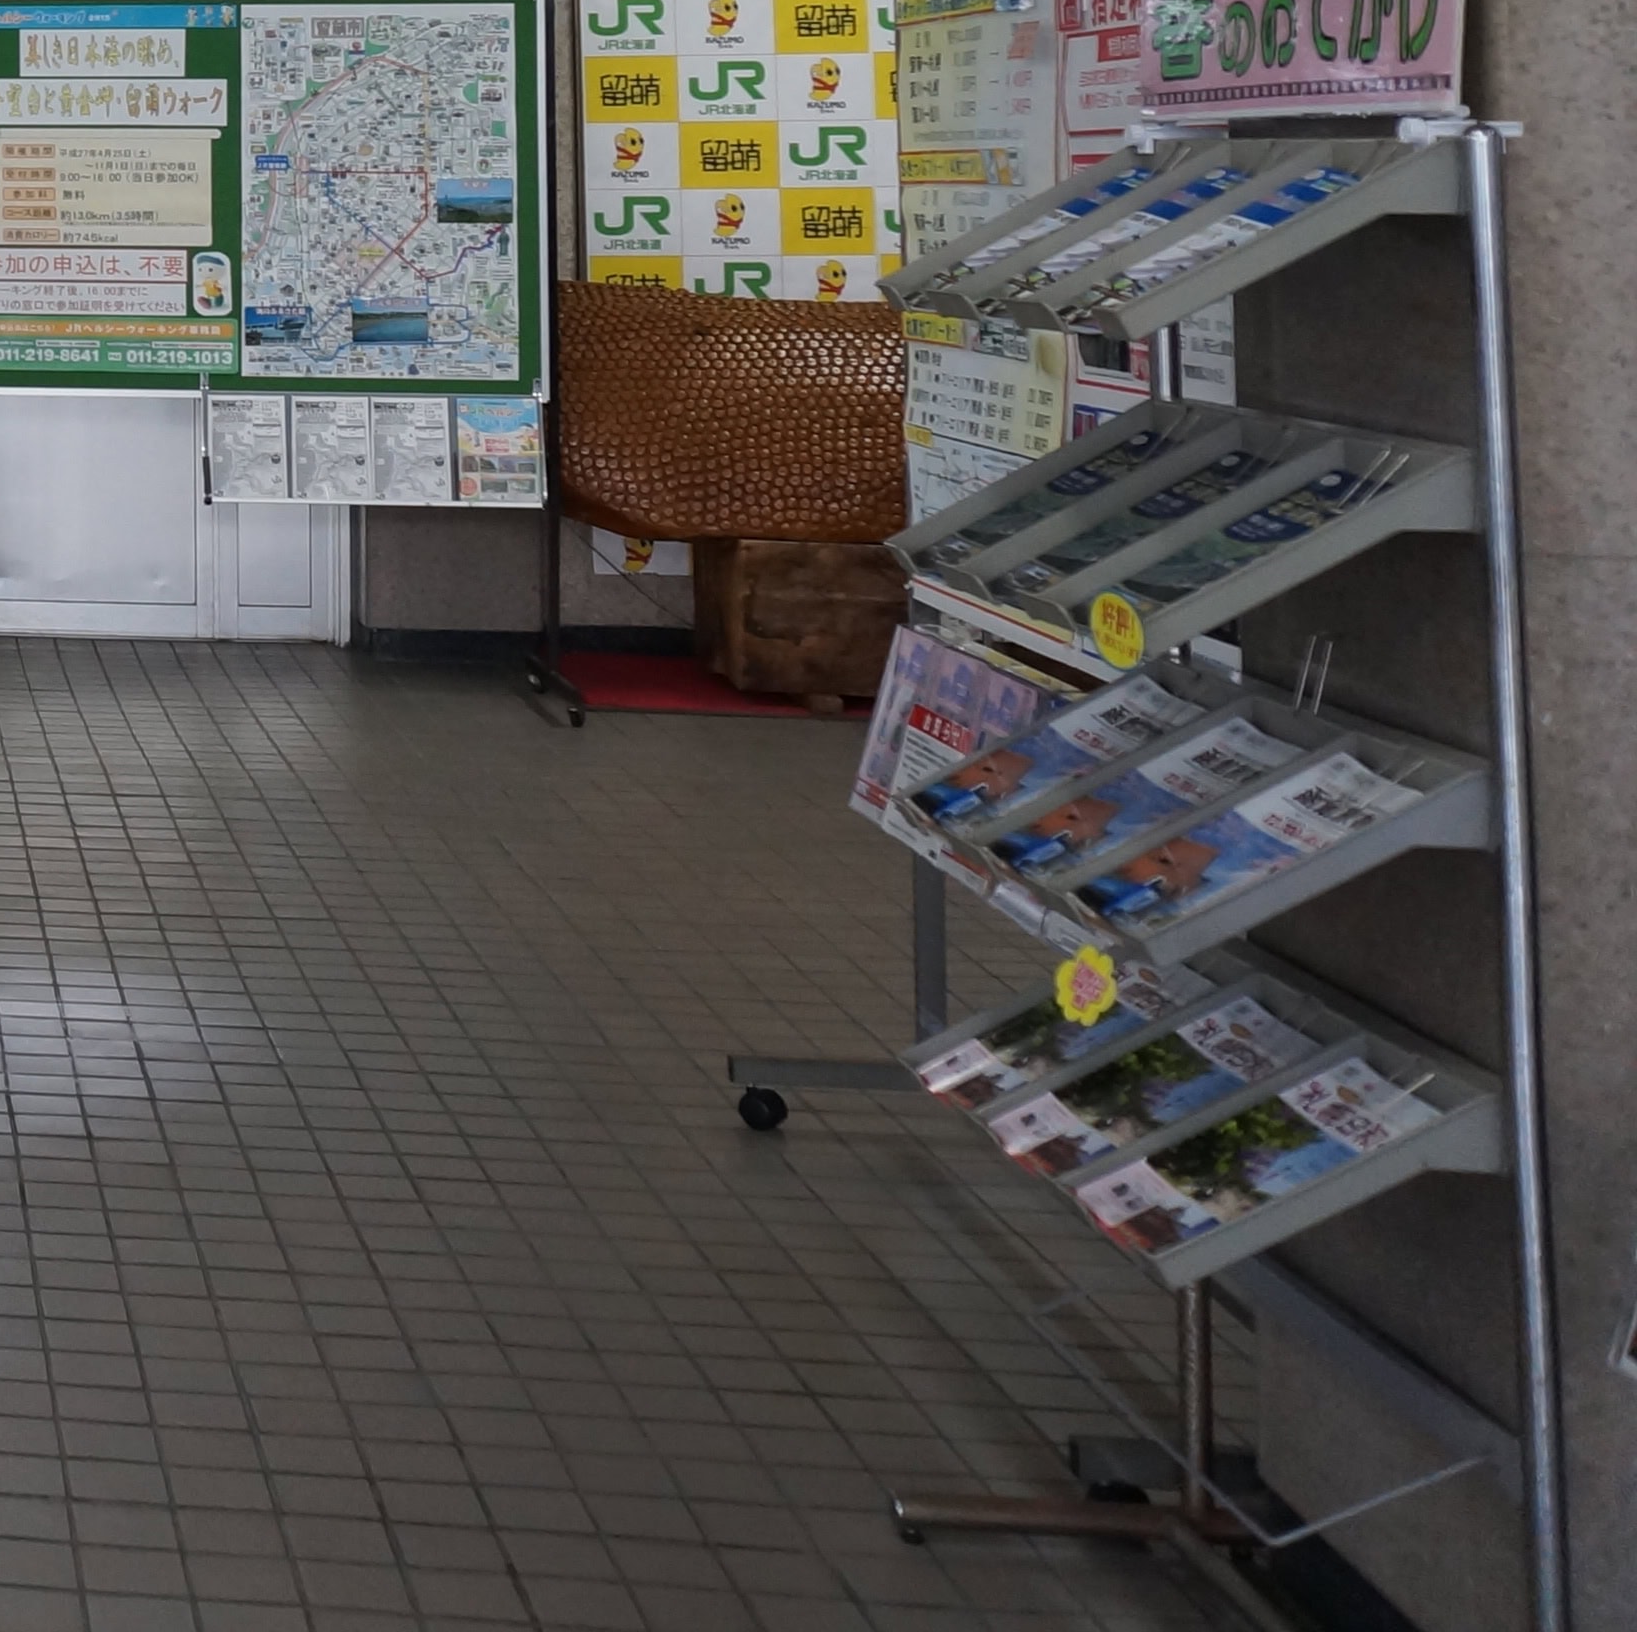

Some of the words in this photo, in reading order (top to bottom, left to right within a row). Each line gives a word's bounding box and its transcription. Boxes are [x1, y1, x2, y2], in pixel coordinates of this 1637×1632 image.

[795, 4, 857, 38] 留萌
[598, 39, 656, 51] JR北海道
[600, 74, 661, 107] 留萌
[689, 61, 766, 101] JR
[699, 104, 757, 116] JR北海道
[700, 139, 762, 173] 留萌
[788, 126, 868, 166] JR
[799, 170, 858, 181] JR北海道
[62, 189, 85, 201] 無料
[593, 196, 671, 236] JR
[802, 205, 864, 239] 留萌
[604, 240, 662, 251] JR北海道
[695, 262, 772, 299] JR
[126, 350, 233, 364] 011-219-1013
